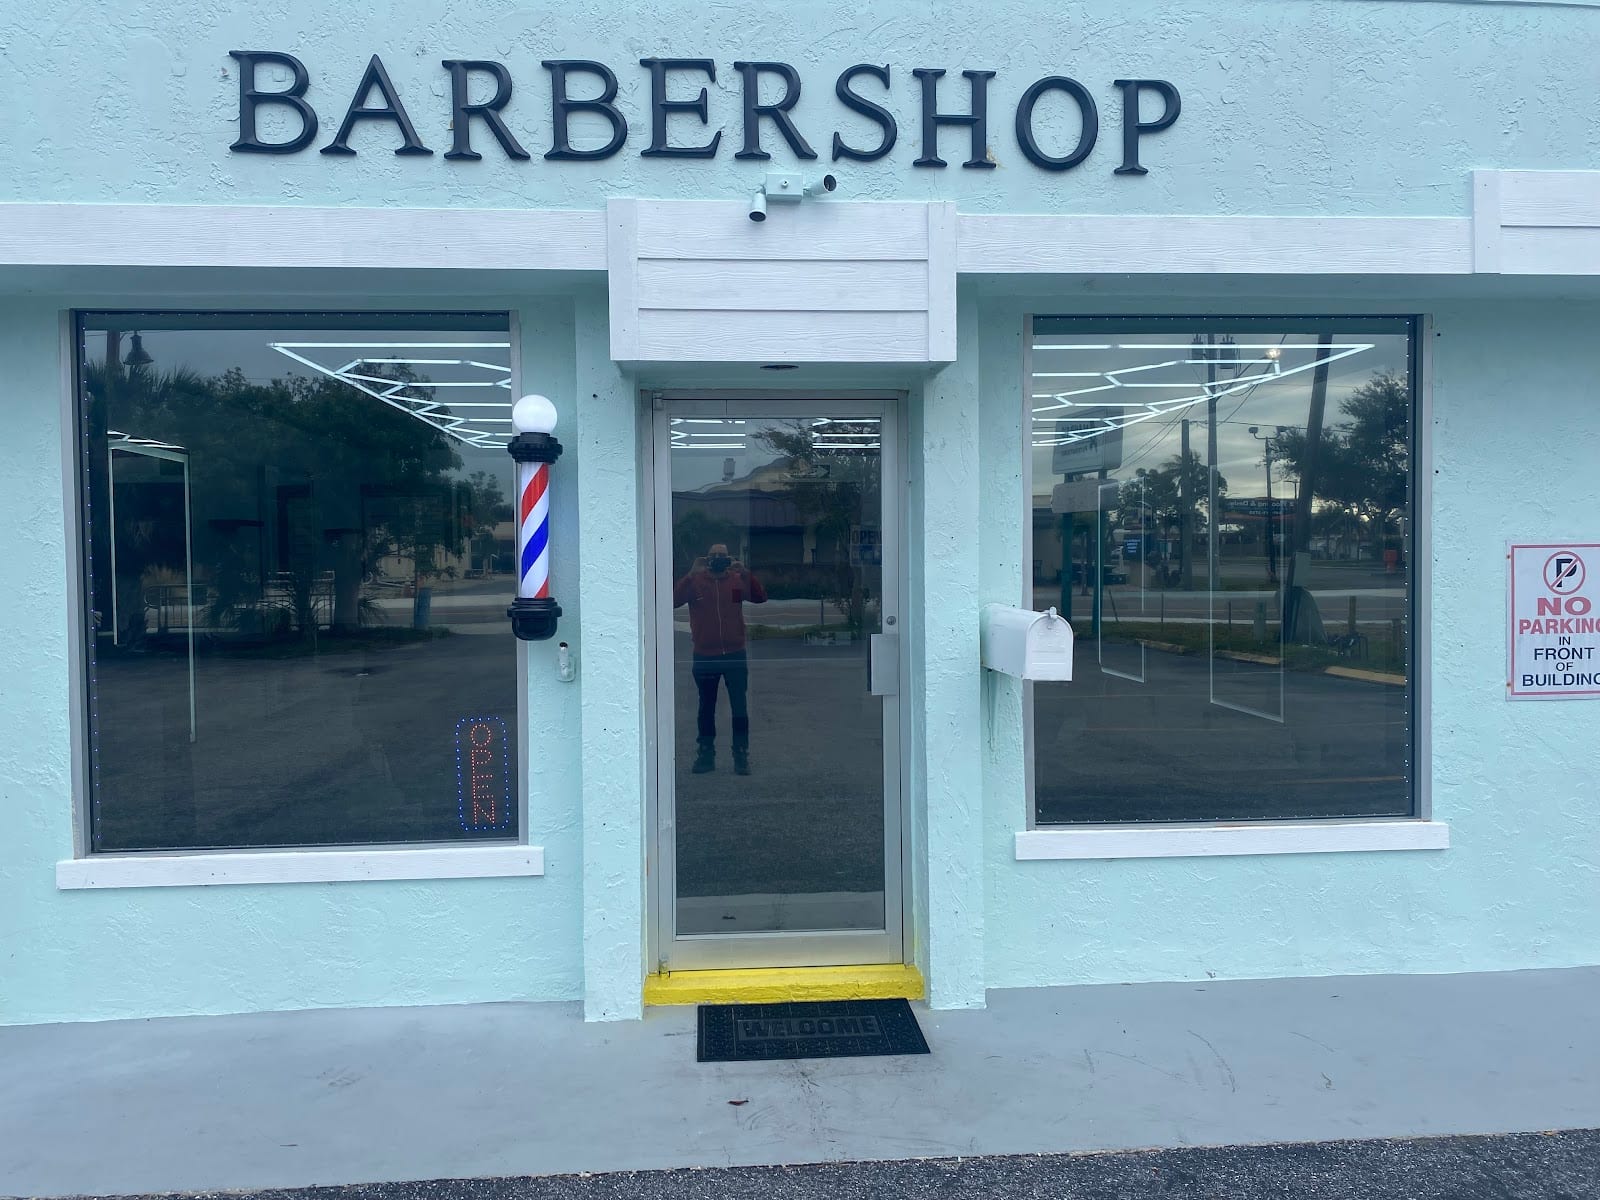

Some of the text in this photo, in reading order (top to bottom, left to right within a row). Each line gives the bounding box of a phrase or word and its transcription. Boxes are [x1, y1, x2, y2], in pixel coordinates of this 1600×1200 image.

[228, 50, 1181, 176] BARBERSHOP
[1537, 596, 1592, 616] NO
[1558, 636, 1571, 646] IN
[1533, 647, 1595, 661] FRONT
[1555, 661, 1574, 671] OF
[470, 723, 496, 825] OPEN
[742, 1017, 876, 1038] WELCOME
